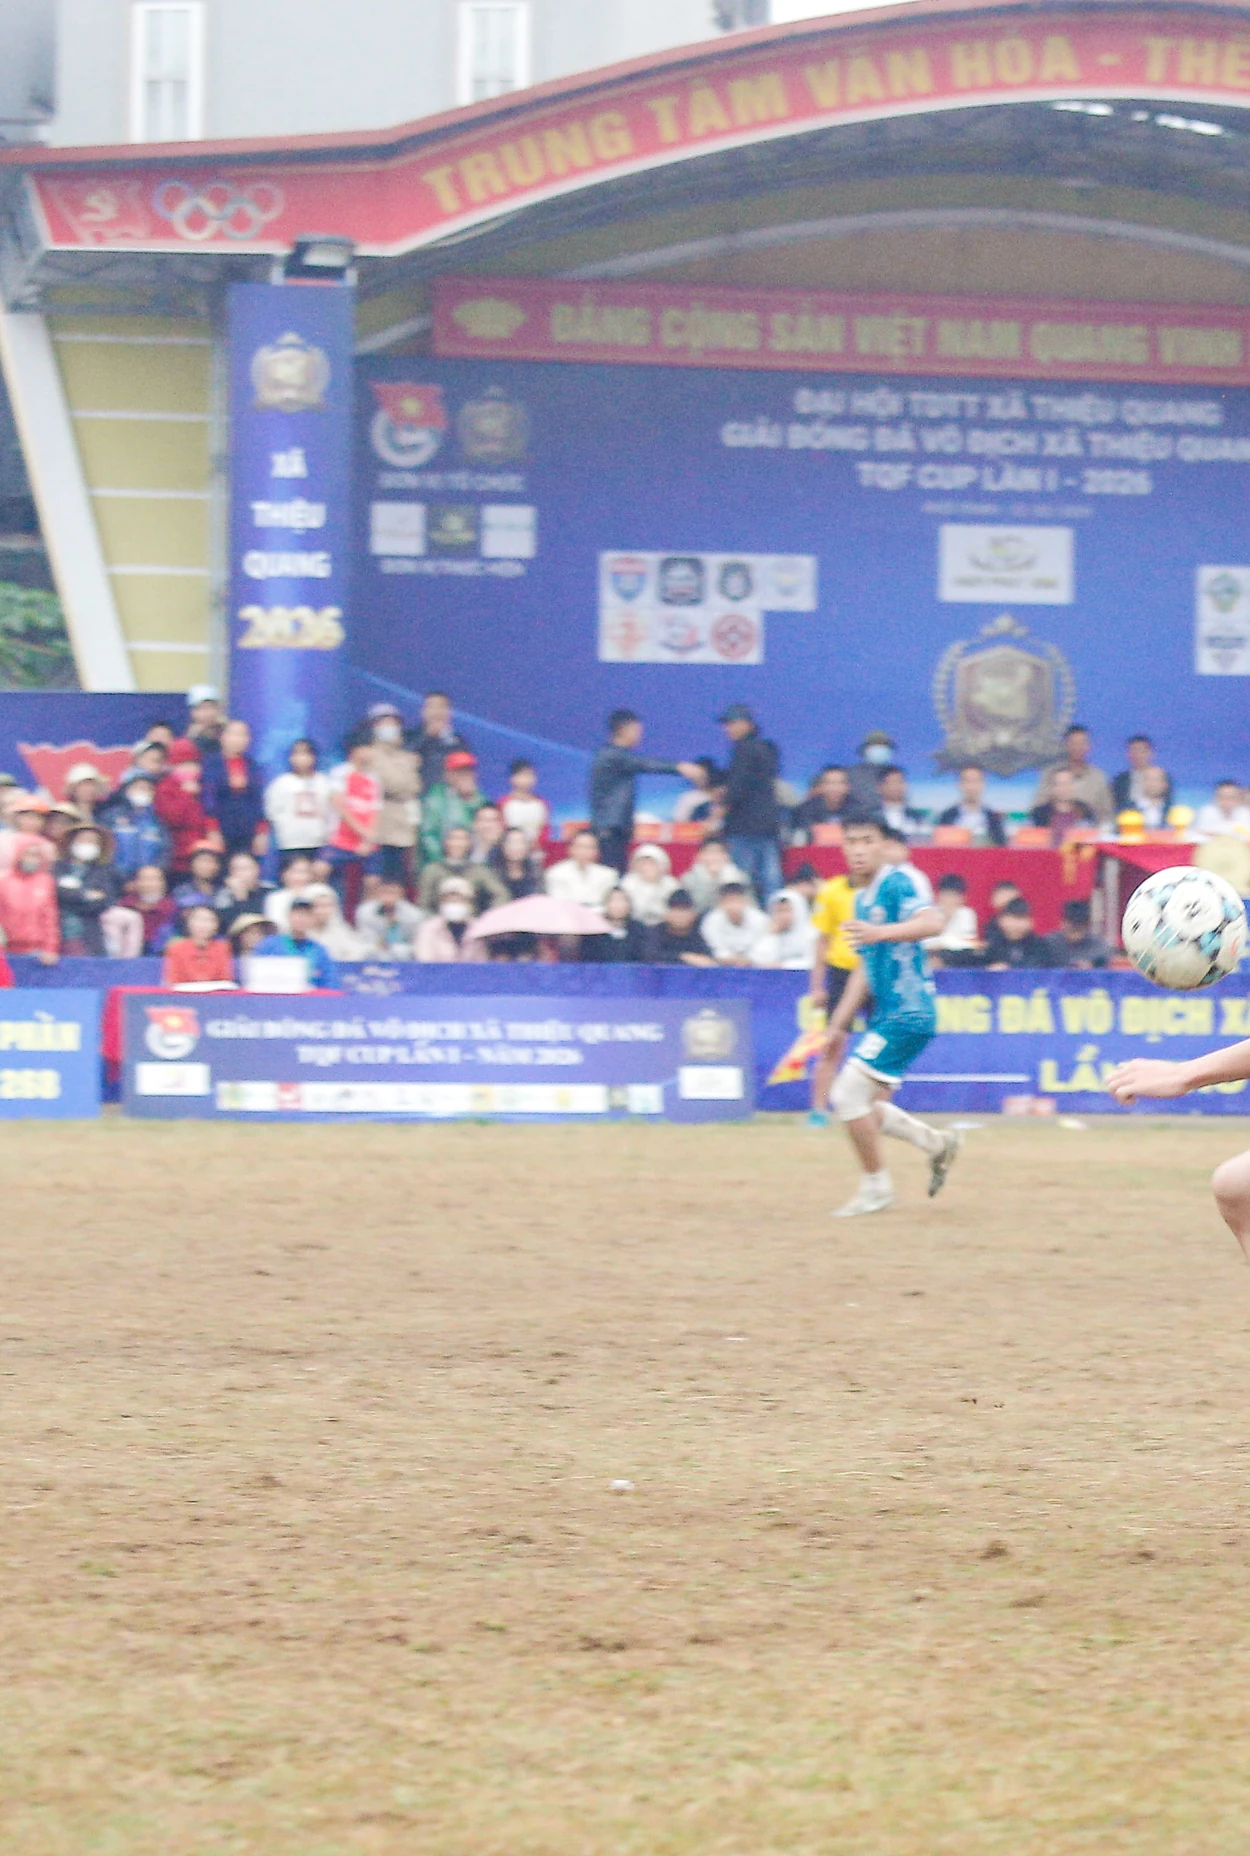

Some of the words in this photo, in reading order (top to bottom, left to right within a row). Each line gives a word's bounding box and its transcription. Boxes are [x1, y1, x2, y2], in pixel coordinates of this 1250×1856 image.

[420, 109, 634, 214] TRUNG
[646, 70, 790, 144] TÂM
[804, 44, 934, 109] VĂN
[948, 28, 1082, 90] HÓA
[550, 294, 653, 347] ĐẢNG
[1121, 400, 1223, 426] QUANG
[1043, 426, 1084, 458] XÃ
[237, 605, 346, 649] 2026
[1000, 987, 1055, 1035] ĐÁ
[1060, 988, 1114, 1035] VÔ
[1120, 995, 1214, 1042] ĐỊCH
